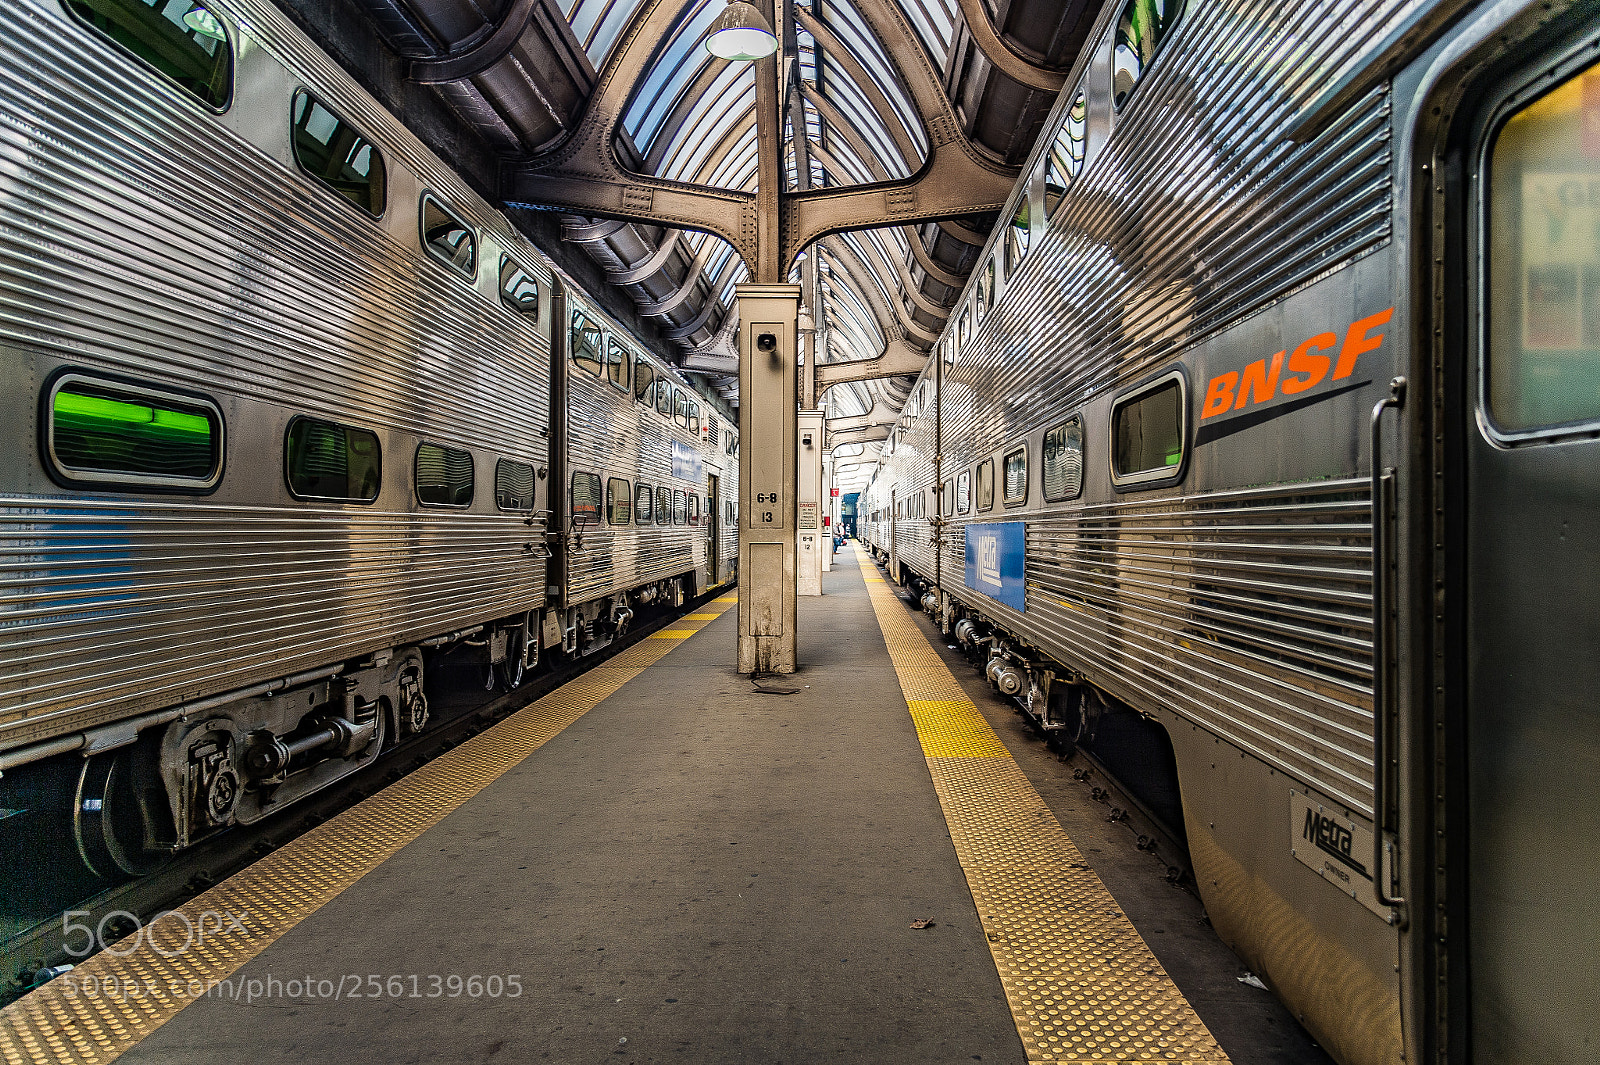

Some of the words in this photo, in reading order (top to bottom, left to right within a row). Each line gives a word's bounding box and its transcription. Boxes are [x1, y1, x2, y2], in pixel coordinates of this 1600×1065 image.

[1201, 306, 1394, 420] BNSF
[757, 493, 777, 503] 6-8
[762, 512, 772, 522] 13
[977, 532, 997, 580] Metra
[1303, 807, 1352, 856] Metra
[1325, 861, 1350, 884] OWNER
